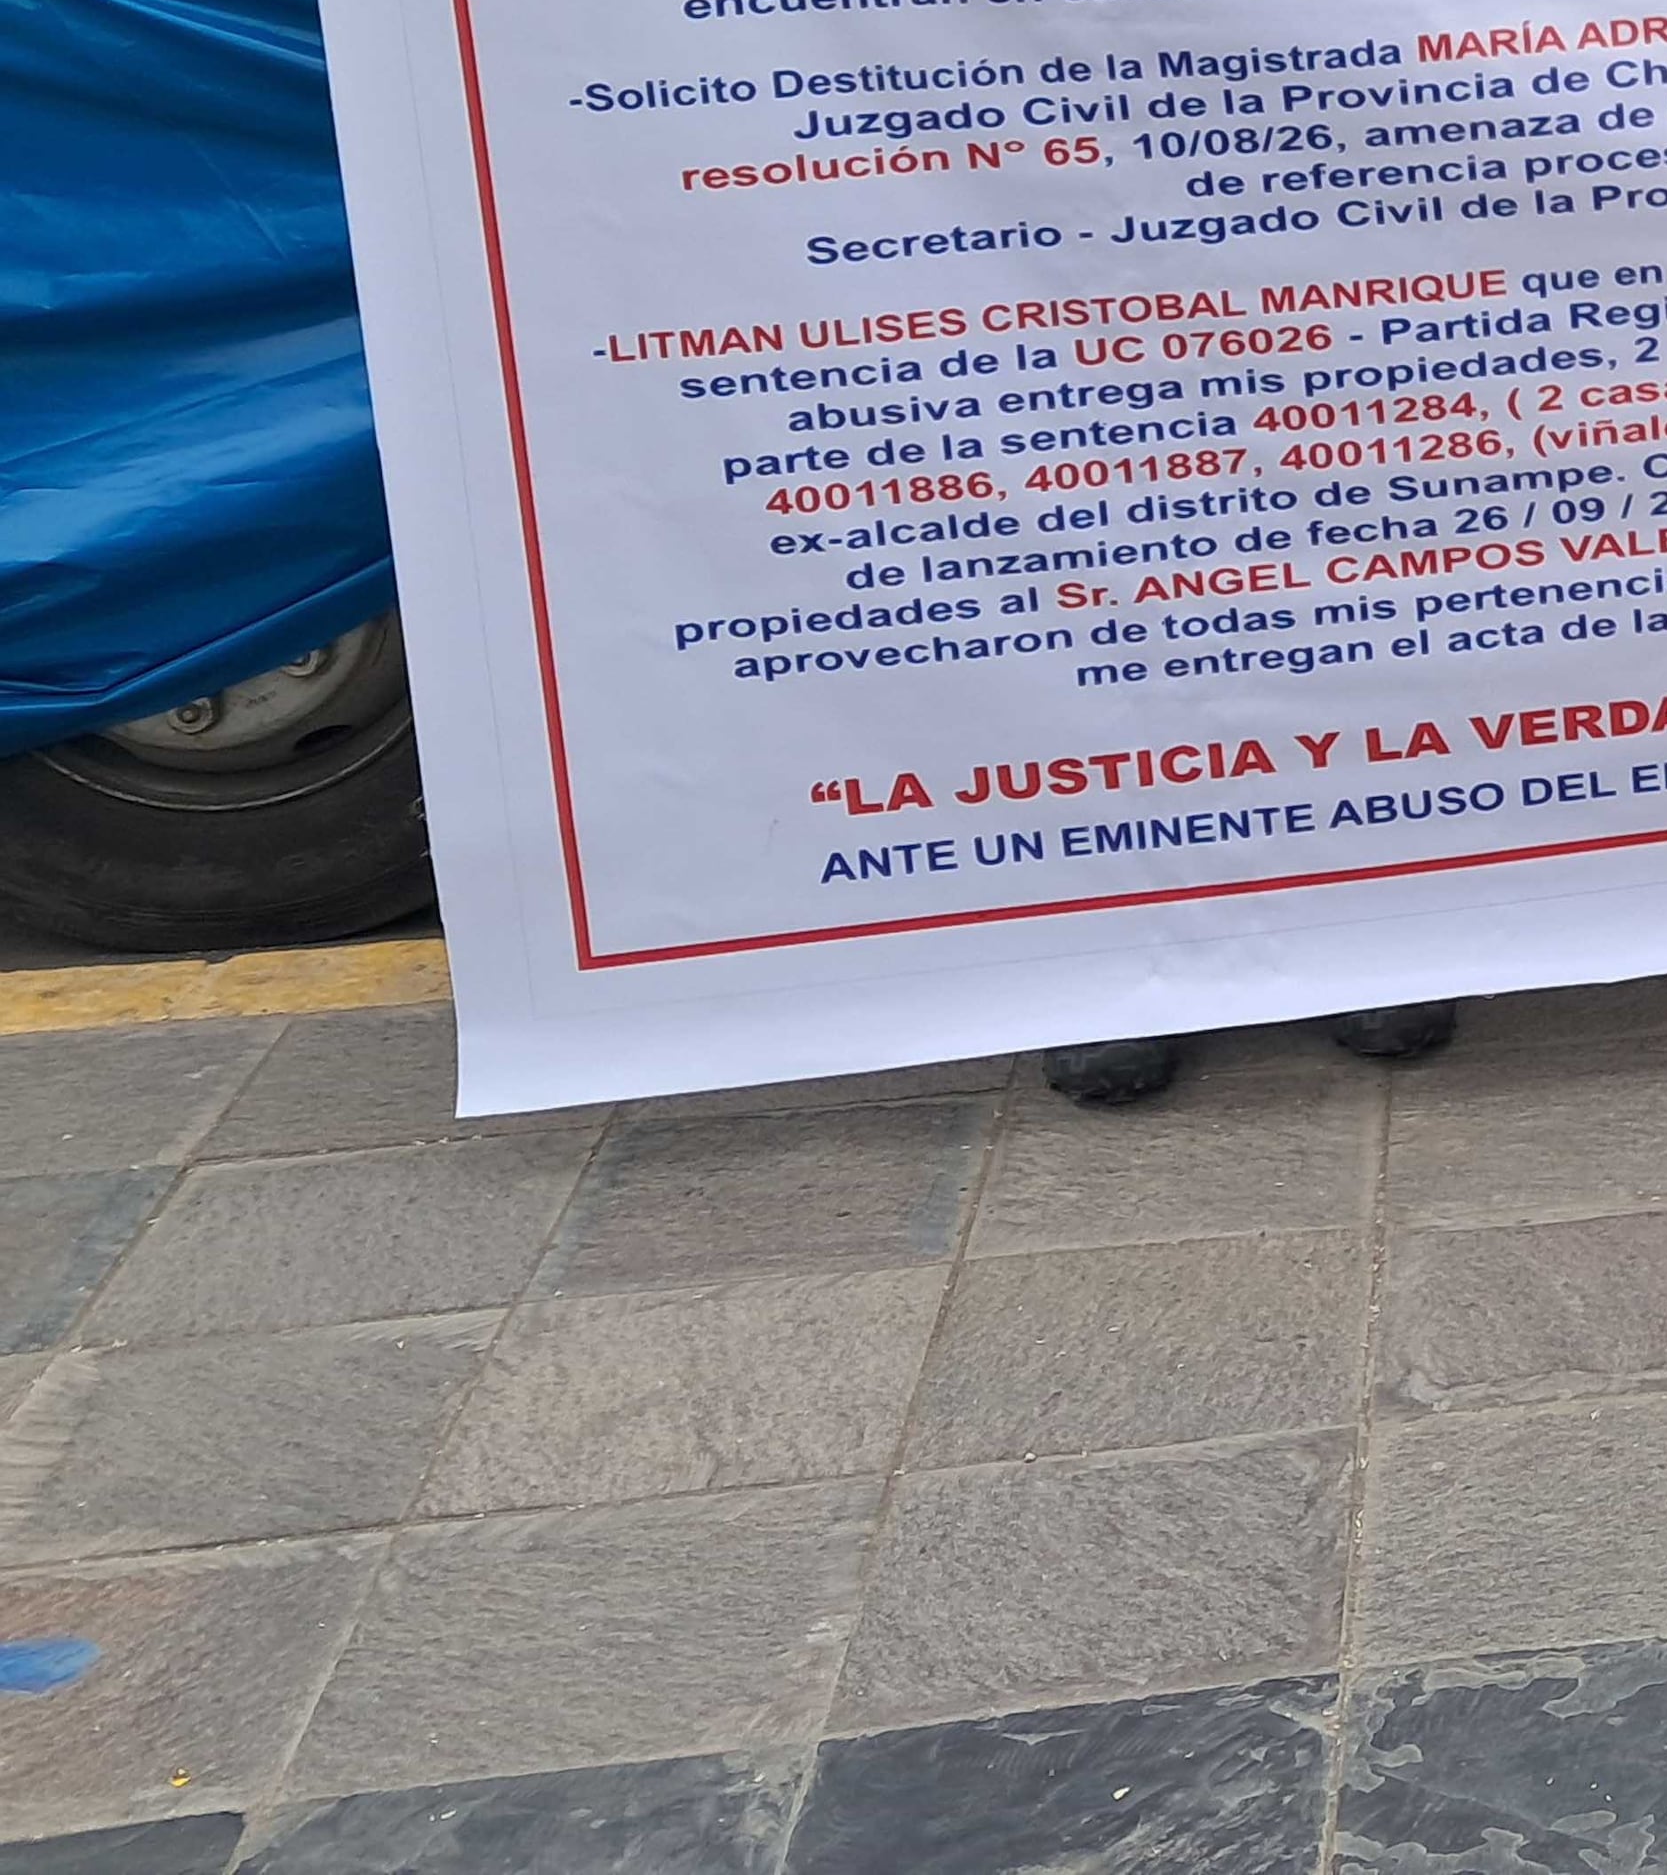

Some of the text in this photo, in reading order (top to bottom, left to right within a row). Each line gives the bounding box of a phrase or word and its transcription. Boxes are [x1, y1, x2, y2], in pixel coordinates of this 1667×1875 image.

[569, 76, 757, 112] -Solicito
[772, 58, 1025, 99] Destitución
[1039, 55, 1093, 84] de
[1106, 53, 1144, 81] la
[1157, 38, 1402, 82] Magistrada
[1417, 19, 1567, 63] MARÍA
[681, 145, 951, 191] resolución
[1043, 136, 1114, 168] 65,
[1132, 123, 1347, 160] 10/08/26,
[1364, 113, 1581, 148] amenaza
[1597, 102, 1655, 132] de
[592, 323, 784, 363] -LITMAN
[799, 307, 968, 349] ULISES
[981, 289, 1248, 333] CRISTOBAL
[1260, 269, 1508, 315] MANRIQUE
[1521, 268, 1601, 299] que
[1614, 264, 1664, 287] en
[723, 445, 851, 486] parte
[866, 437, 926, 467] de
[941, 433, 985, 462] la
[1000, 410, 1237, 455] sentencia
[1252, 391, 1489, 433] 40011284,
[1537, 384, 1564, 412] 2
[765, 471, 1007, 516] 40011886,
[1024, 447, 1263, 493] 40011887,
[1279, 429, 1515, 471] 40011286,
[674, 597, 982, 651] propiedades
[999, 586, 1039, 615] al
[1056, 581, 1119, 609] Sr.
[1132, 561, 1312, 604] ANGEL
[1326, 539, 1545, 585] CAMPOS
[1076, 661, 1148, 687] me
[1163, 640, 1374, 678] entregan
[1390, 628, 1430, 658] el
[1447, 621, 1545, 653] acta
[1560, 613, 1617, 641] de
[954, 739, 1278, 805] JUSTICIA
[1293, 731, 1341, 769] Y
[1364, 721, 1452, 763] LA
[820, 839, 959, 885] ANTE
[973, 830, 1044, 866] UN
[1060, 803, 1316, 858] EMINENTE
[1328, 782, 1505, 830] ABUSO
[1521, 770, 1618, 807] DEL
